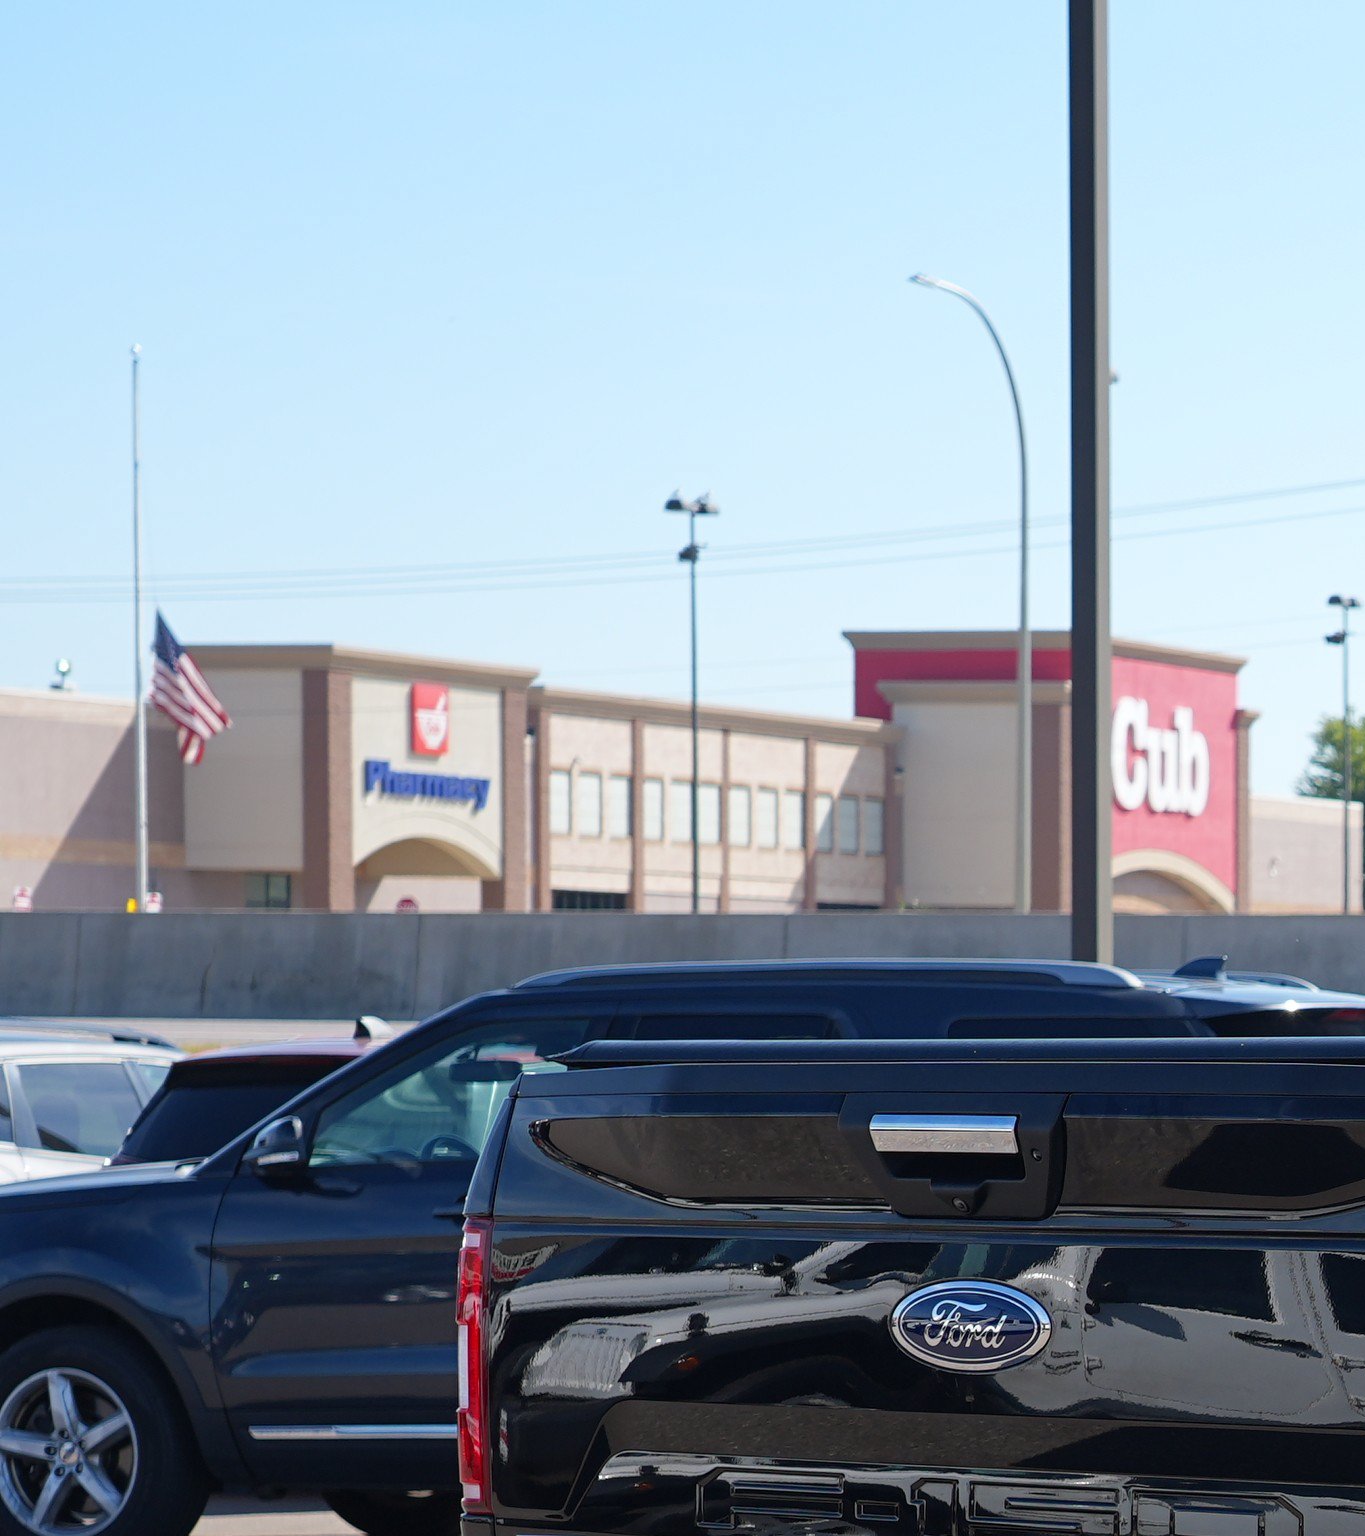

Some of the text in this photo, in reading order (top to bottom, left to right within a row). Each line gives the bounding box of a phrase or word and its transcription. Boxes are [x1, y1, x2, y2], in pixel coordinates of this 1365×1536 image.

[1111, 696, 1209, 816] Cub
[363, 760, 490, 811] Pharmacy
[923, 1299, 1008, 1349] Ford
